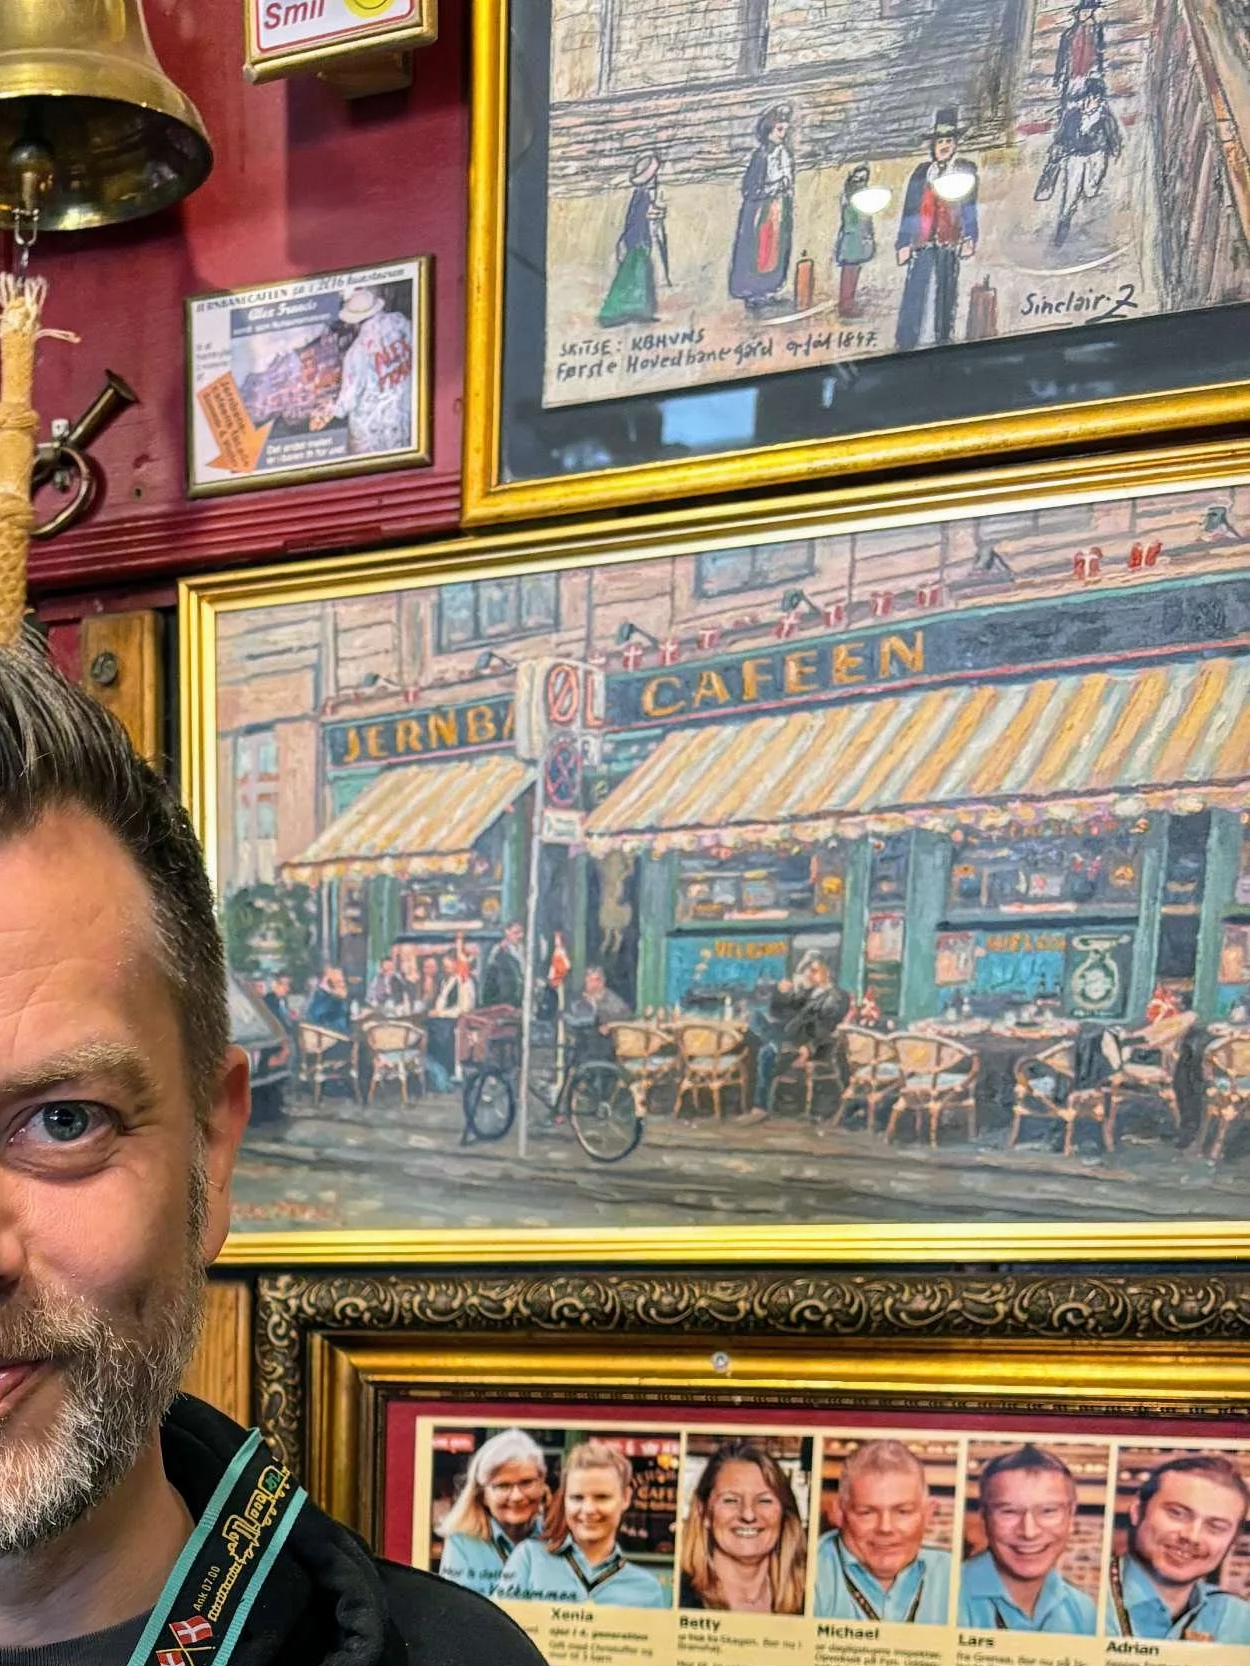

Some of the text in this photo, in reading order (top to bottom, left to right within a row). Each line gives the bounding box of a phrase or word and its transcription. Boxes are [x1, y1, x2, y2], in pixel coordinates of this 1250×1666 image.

[264, 0, 325, 30] Smil
[642, 630, 924, 717] CAFEEN
[548, 664, 604, 727] ØL
[193, 1566, 220, 1611] Ank 07.00
[551, 1608, 593, 1621] Xenia
[680, 1616, 720, 1632] Betty
[817, 1624, 879, 1639] Michael
[958, 1634, 994, 1647] Lars
[1106, 1641, 1159, 1655] Adrian
